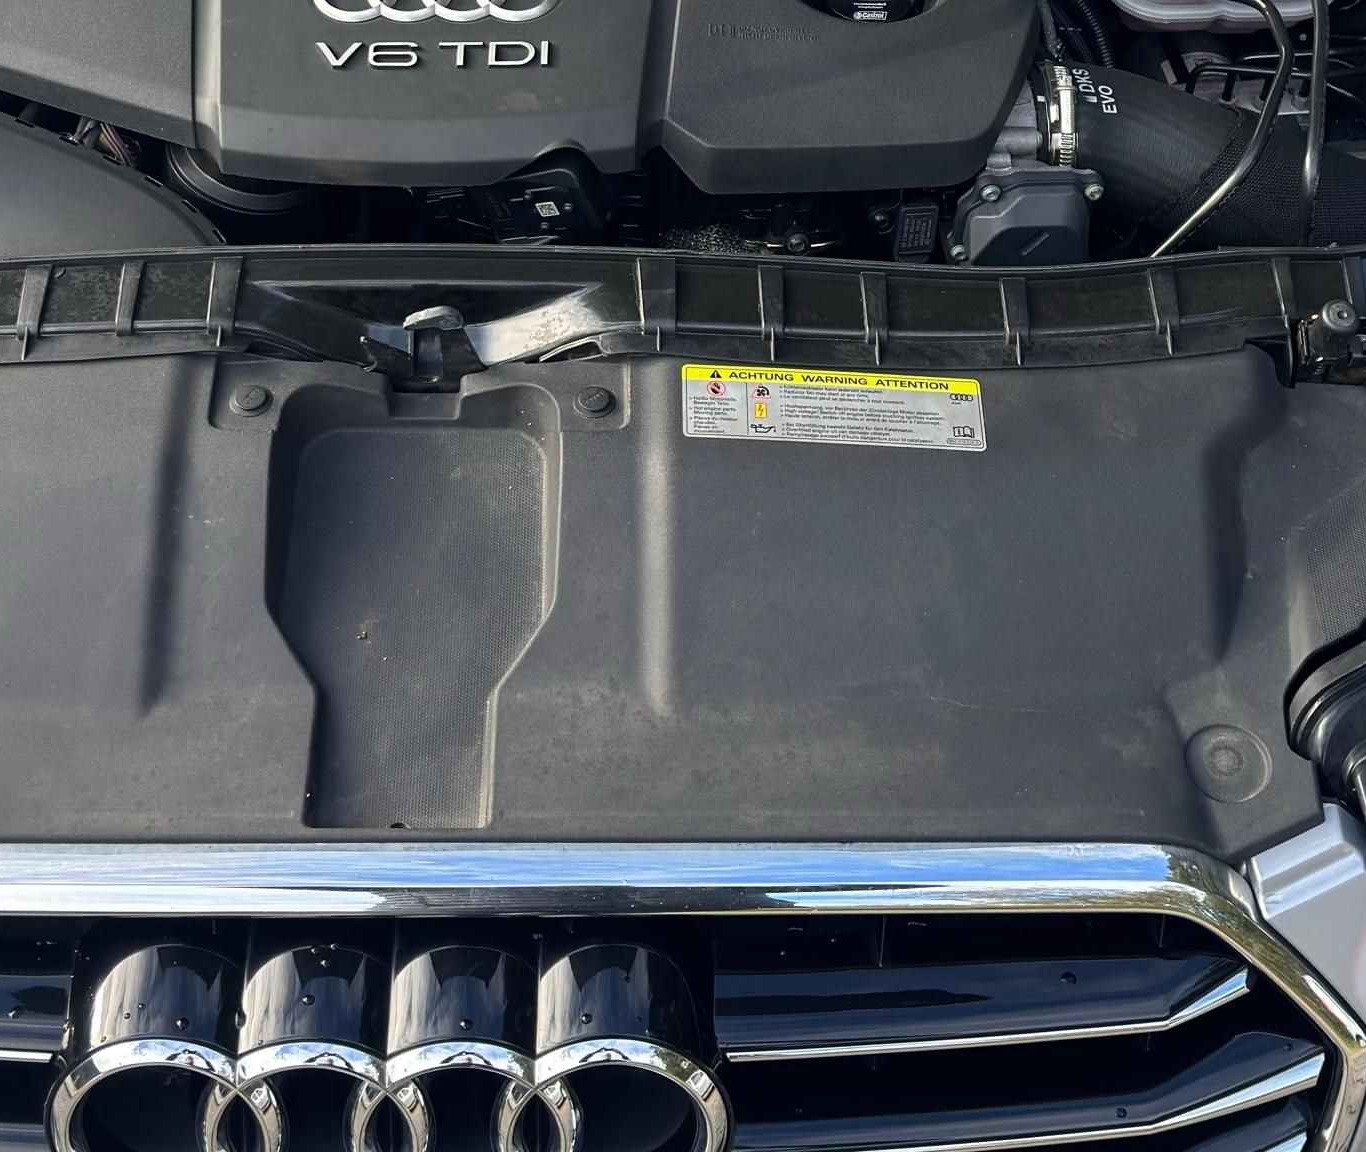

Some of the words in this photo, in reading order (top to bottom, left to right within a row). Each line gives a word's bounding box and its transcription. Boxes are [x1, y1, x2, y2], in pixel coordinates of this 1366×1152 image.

[315, 41, 419, 68] V6
[439, 40, 550, 68] TDI
[1098, 85, 1118, 114] EVO
[729, 371, 794, 381] ACHTUNG
[801, 375, 868, 385] WARNING
[876, 379, 949, 390] ATTENTION
